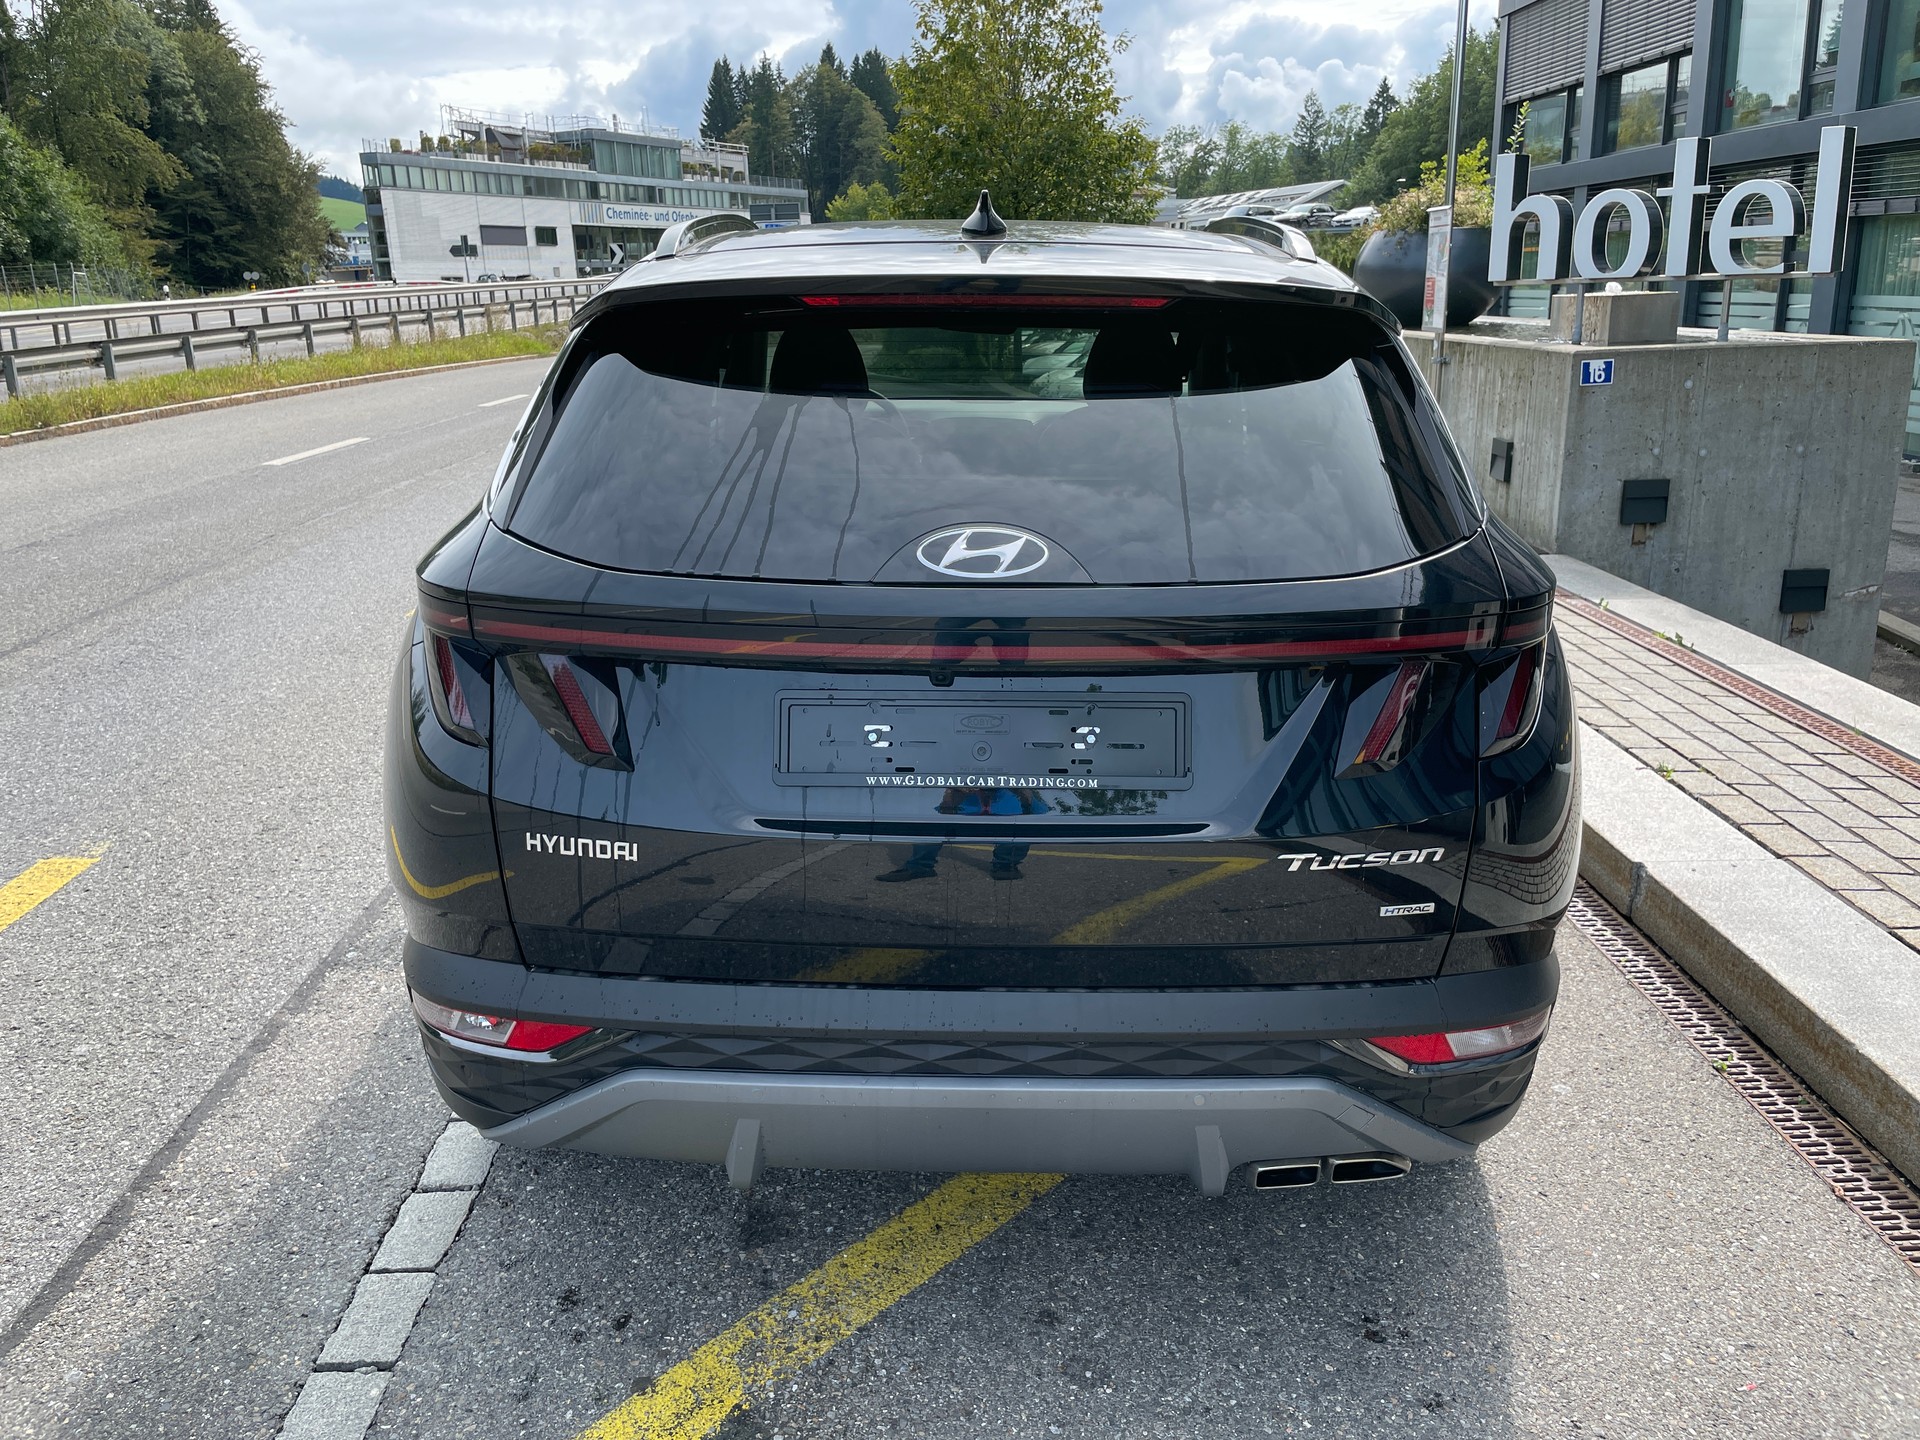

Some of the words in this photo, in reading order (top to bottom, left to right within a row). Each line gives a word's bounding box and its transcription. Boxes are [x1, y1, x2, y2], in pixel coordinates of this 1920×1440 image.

[606, 207, 652, 221] Cheminée-
[654, 210, 670, 222] und
[671, 210, 698, 222] Ofenb
[1488, 125, 1857, 282] hotel
[525, 831, 639, 862] HYUNDAI
[1276, 846, 1446, 872] TUCSON
[1383, 904, 1432, 915] HTRAC
